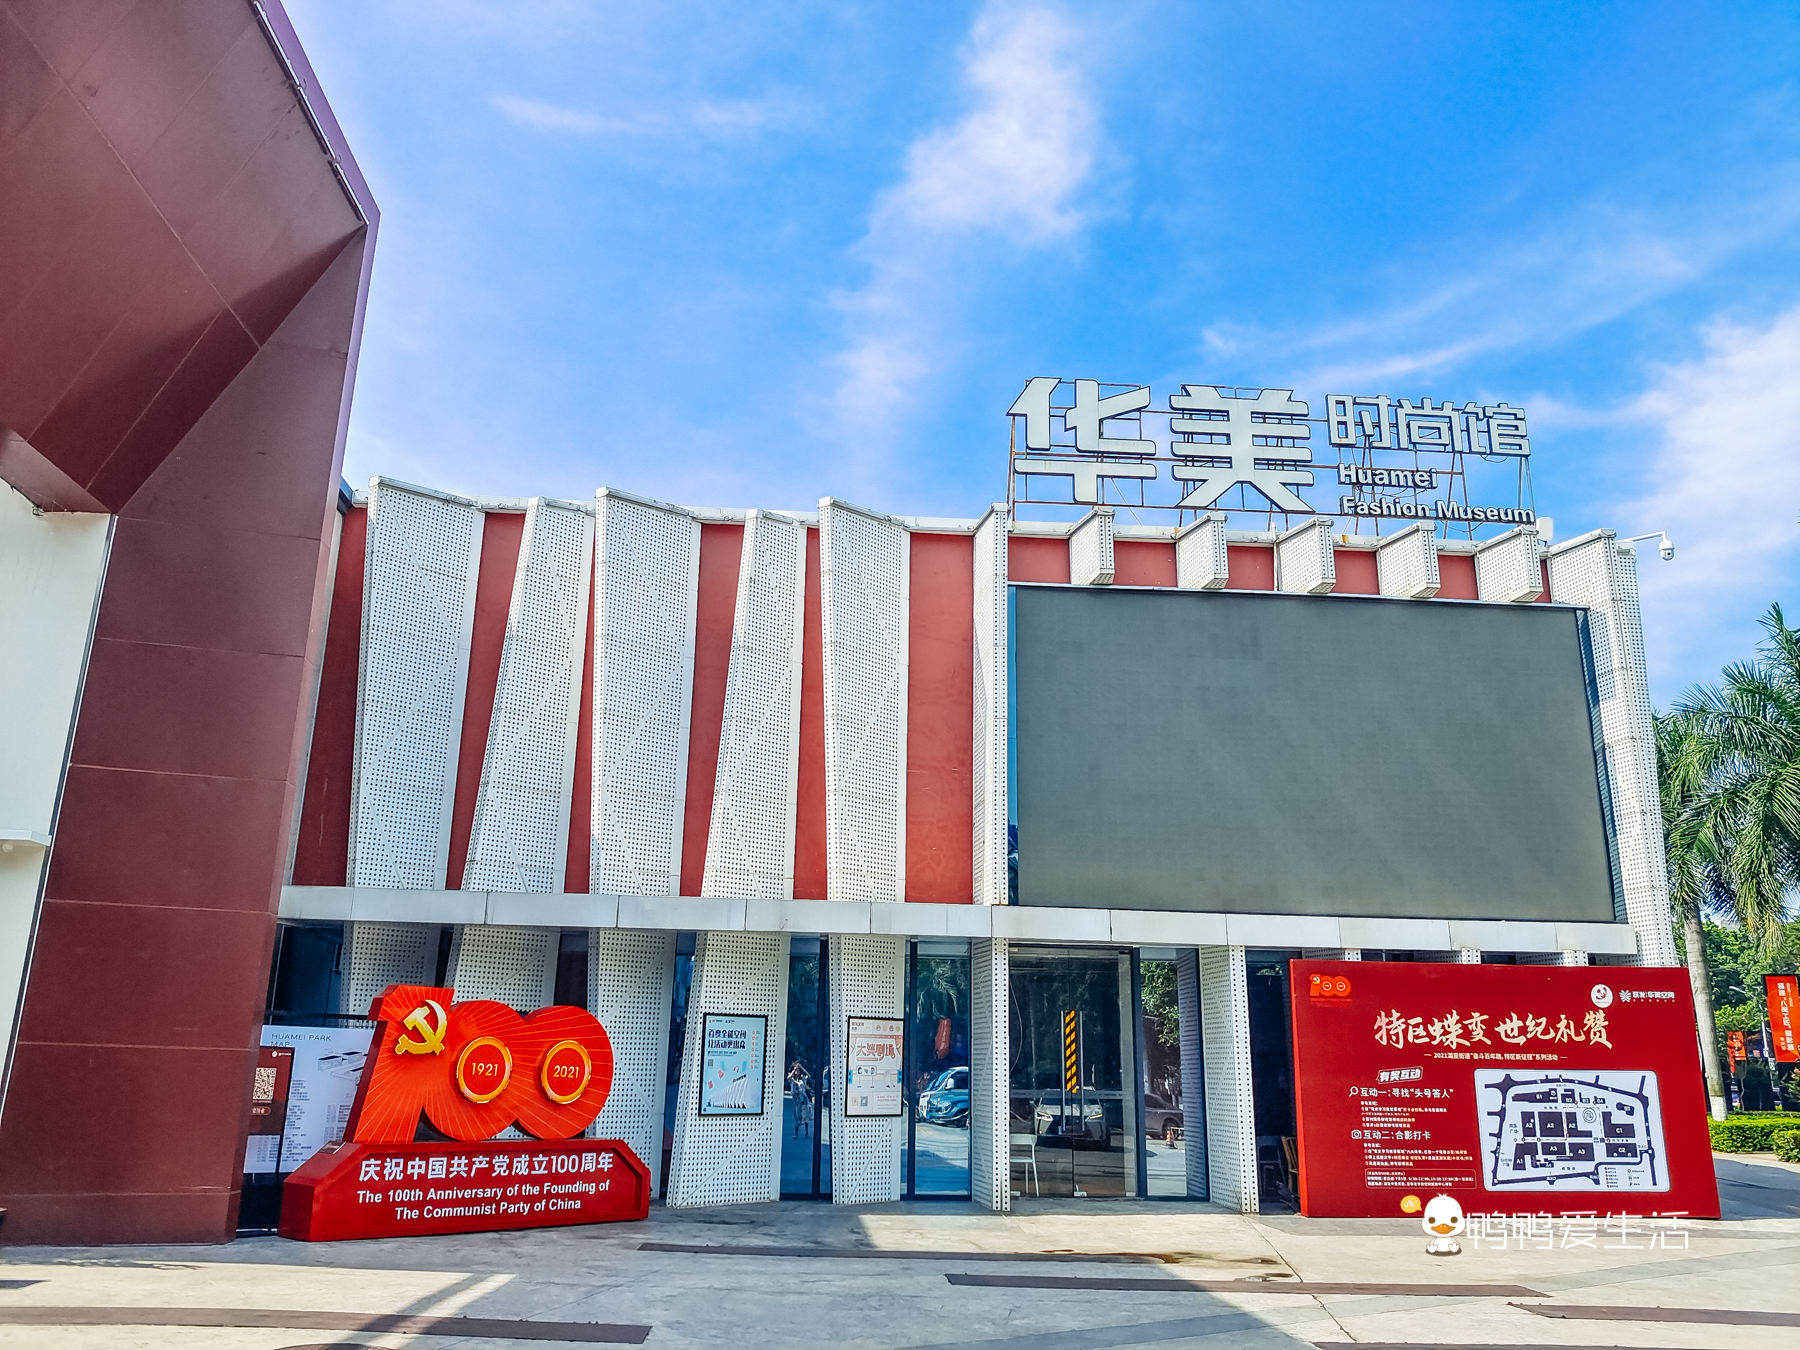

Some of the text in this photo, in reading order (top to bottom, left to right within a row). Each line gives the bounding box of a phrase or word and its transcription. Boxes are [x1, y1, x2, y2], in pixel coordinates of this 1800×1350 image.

[1326, 394, 1531, 457] 时尚馆
[1006, 376, 1316, 513] 华美
[1338, 462, 1438, 489] Huamei
[1341, 496, 1535, 524] Fashion Museum
[271, 1033, 306, 1041] HUAMEI
[1373, 1008, 1613, 1050] 特区蝶变 世纪礼赞
[471, 1062, 499, 1077] 1921
[553, 1065, 579, 1079] 2021
[1380, 1068, 1421, 1082] 有奖互动
[359, 1152, 614, 1182] 庆祝中国共产党成立100周年
[357, 1179, 611, 1204] The 100th Anniversary of the Founding of
[395, 1197, 581, 1220] The Communist Party of China
